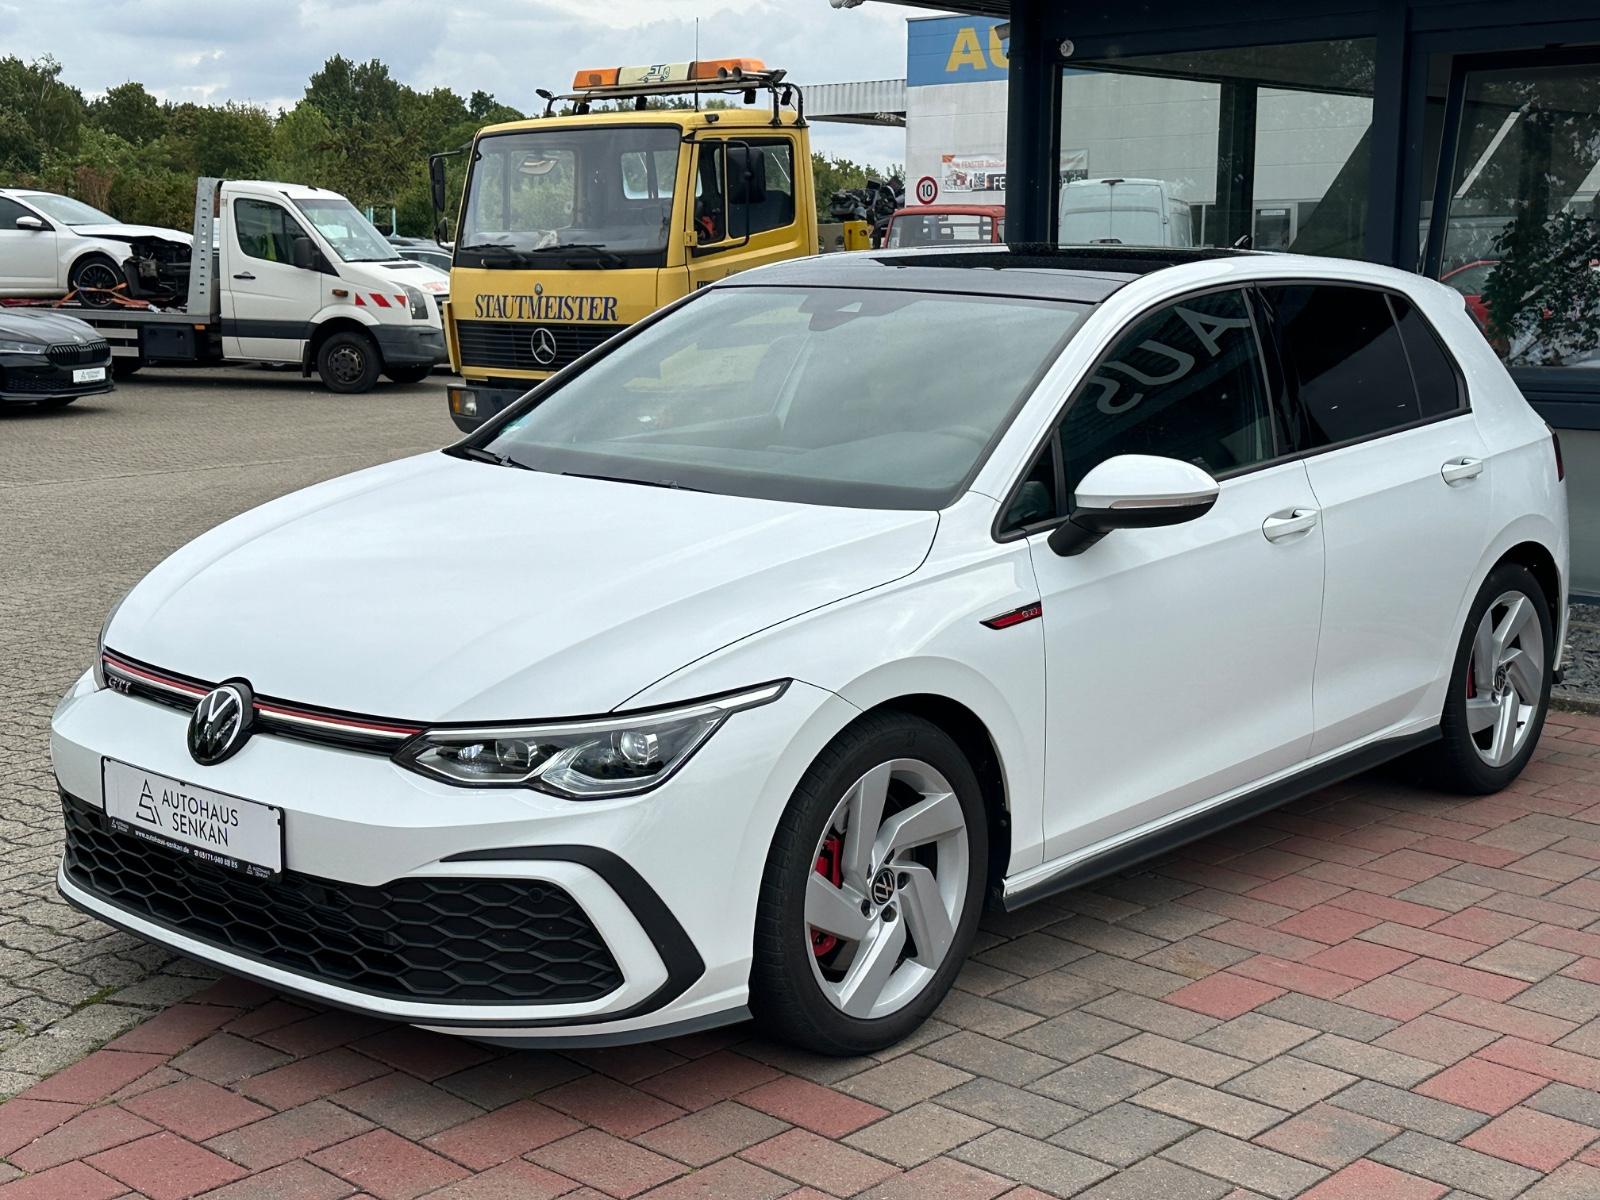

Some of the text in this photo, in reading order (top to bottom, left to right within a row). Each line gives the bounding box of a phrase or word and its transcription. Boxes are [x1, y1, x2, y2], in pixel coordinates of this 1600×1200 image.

[921, 184, 933, 198] 10
[474, 294, 619, 322] STAUTMEISTER
[1021, 607, 1038, 619] GTI
[108, 676, 132, 694] GTI
[162, 788, 239, 827] AUTOHAUS
[172, 811, 229, 847] SENKAN
